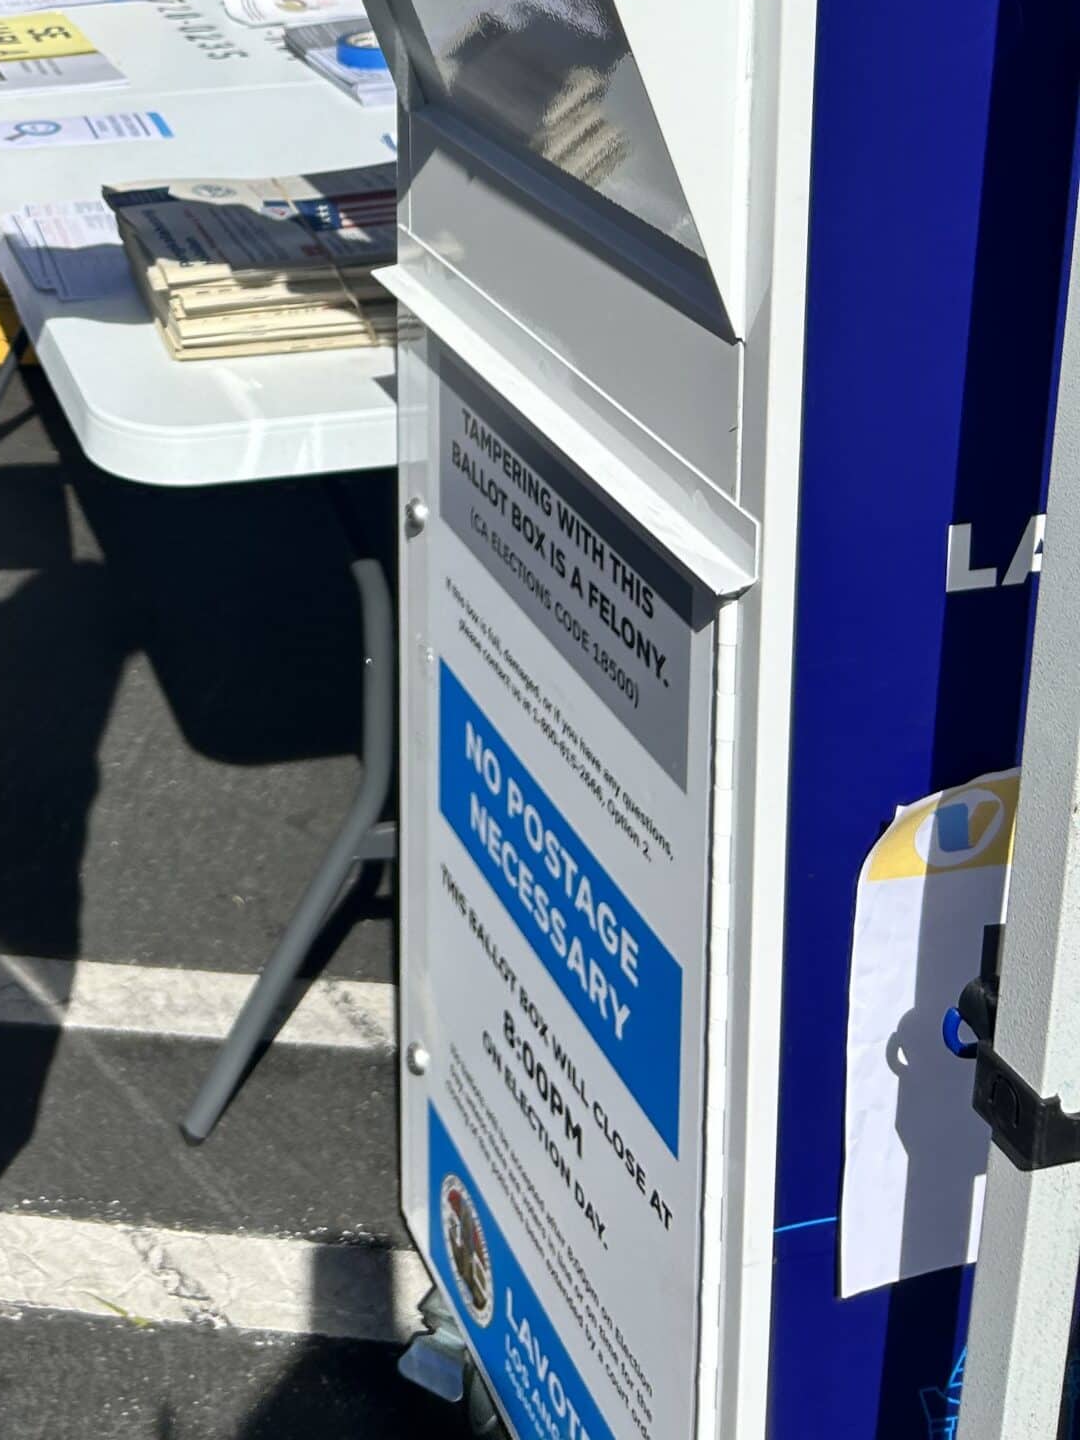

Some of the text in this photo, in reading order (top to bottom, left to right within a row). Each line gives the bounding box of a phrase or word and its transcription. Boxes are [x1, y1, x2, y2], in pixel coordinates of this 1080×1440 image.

[451, 439, 669, 689] BALLOT BOX IS A FELONY.
[461, 407, 655, 620] TAMPERING WITH THIS
[469, 504, 640, 710] (CA ELECTIONS CODE 18500)
[465, 720, 639, 988] NO POSTAGE
[562, 719, 578, 746] you
[579, 737, 602, 773] have
[603, 767, 622, 798] any
[622, 791, 674, 862] questions,
[607, 798, 640, 848] Option
[470, 791, 631, 1041] NECESSARY
[440, 861, 674, 1232] THIS BALLOT BOX WILL CLOSE AT
[482, 1029, 608, 1251] ON ELECTION DAY.
[503, 1008, 583, 1160] 8:00PM
[615, 1325, 653, 1399] Election
[620, 1361, 634, 1391] for
[635, 1388, 653, 1424] the
